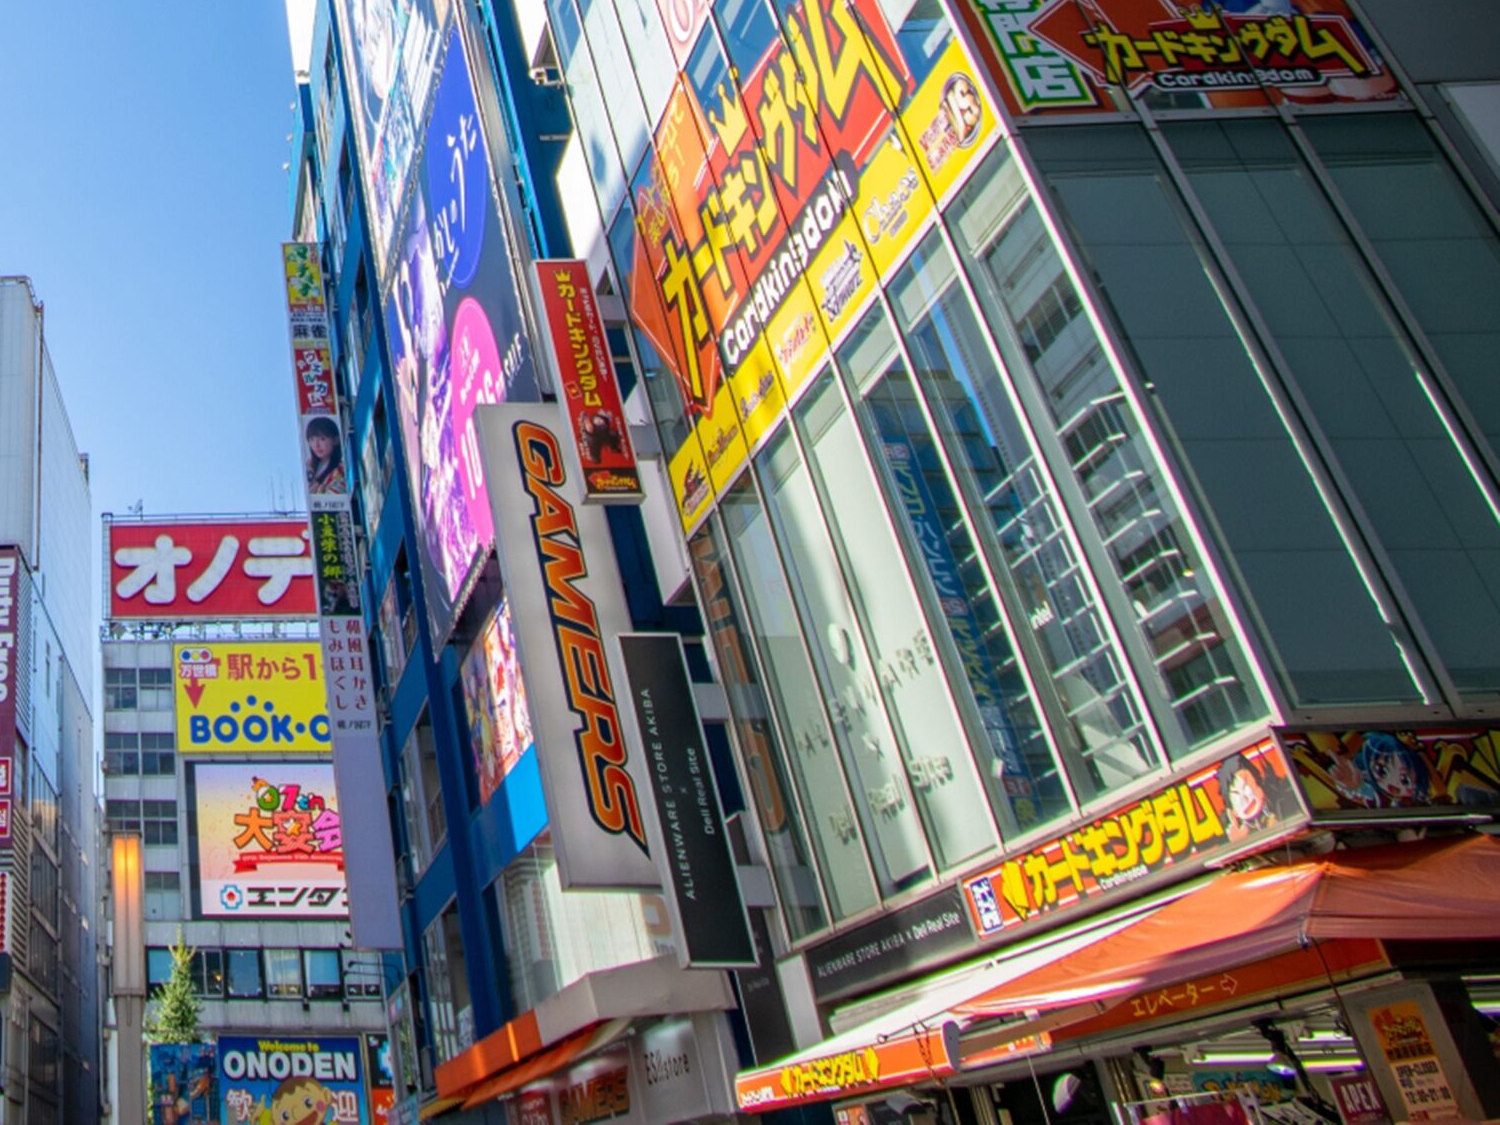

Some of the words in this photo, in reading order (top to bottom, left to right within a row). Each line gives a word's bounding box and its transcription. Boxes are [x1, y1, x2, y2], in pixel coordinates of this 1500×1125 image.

[1086, 17, 1372, 84] カードキングダム
[293, 324, 328, 339] 麻雀
[557, 282, 603, 408] カードキングダム
[510, 419, 652, 862] GAMERS
[227, 653, 324, 682] 駅から1
[639, 687, 663, 739] AKIBA
[653, 739, 676, 794] STORE
[664, 795, 697, 902] ALIENWARE
[1024, 782, 1224, 909] カードキングダム
[855, 940, 882, 963] STORE
[881, 931, 906, 954] AKIBA
[942, 911, 961, 929] Site
[1130, 981, 1216, 1018] エレベーター
[222, 1050, 357, 1080] ONODEN
[257, 1040, 305, 1052] Welcome
[307, 1041, 320, 1052] to
[1340, 1080, 1380, 1114] APEX
